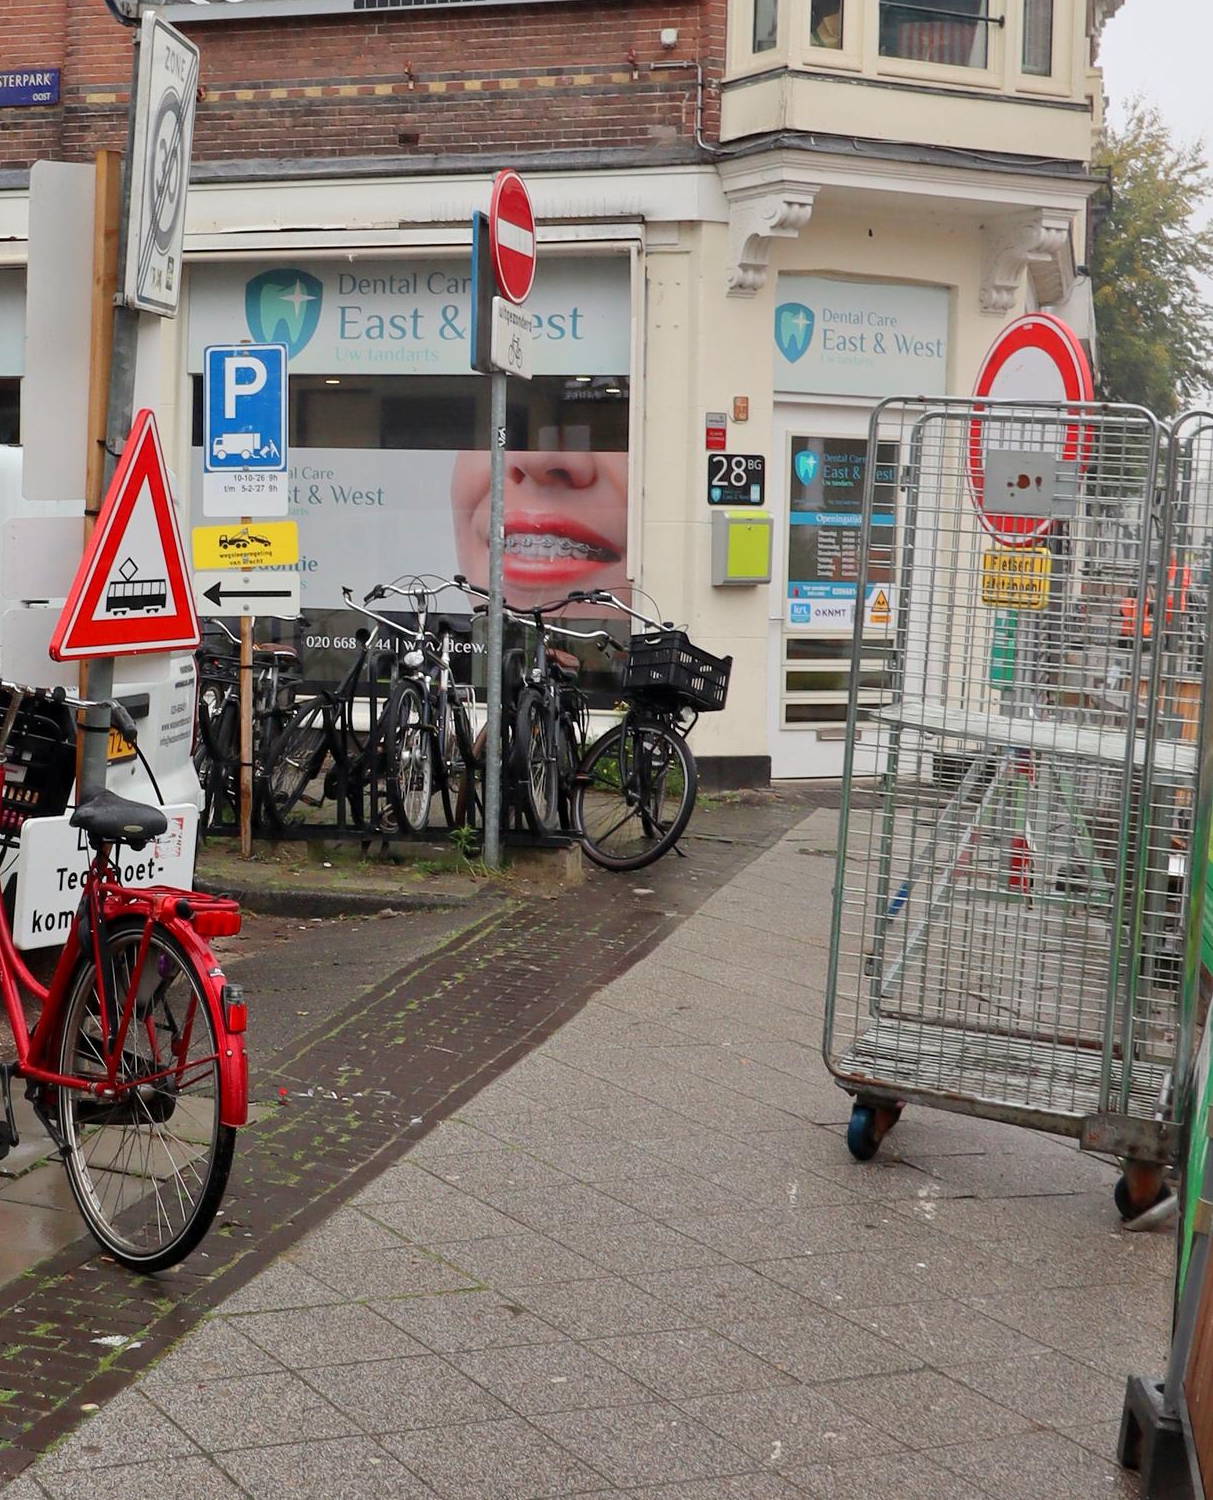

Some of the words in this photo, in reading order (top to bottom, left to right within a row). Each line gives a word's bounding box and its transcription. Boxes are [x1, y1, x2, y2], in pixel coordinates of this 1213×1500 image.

[163, 45, 186, 84] ZONE
[32, 92, 51, 101] OOST
[338, 272, 418, 295] Dental
[426, 271, 472, 295] Car
[338, 305, 425, 340] East
[438, 304, 468, 340] &
[822, 307, 864, 325] Dental
[867, 311, 898, 328] Care
[822, 328, 867, 353] East
[873, 331, 887, 355] &
[894, 333, 946, 359] West
[335, 347, 364, 362] Uw
[367, 346, 440, 363] tandarts
[224, 356, 268, 419] P
[823, 454, 848, 463] Dental
[302, 467, 334, 480] Care
[711, 456, 747, 487] 28
[748, 459, 762, 470] BG
[823, 465, 849, 479] East
[852, 466, 861, 480] &
[308, 485, 323, 504] &
[331, 484, 385, 506] West
[816, 513, 863, 524] Openingstijd
[821, 609, 847, 617] KNMT
[306, 636, 330, 649] 020
[333, 636, 357, 649] 668
